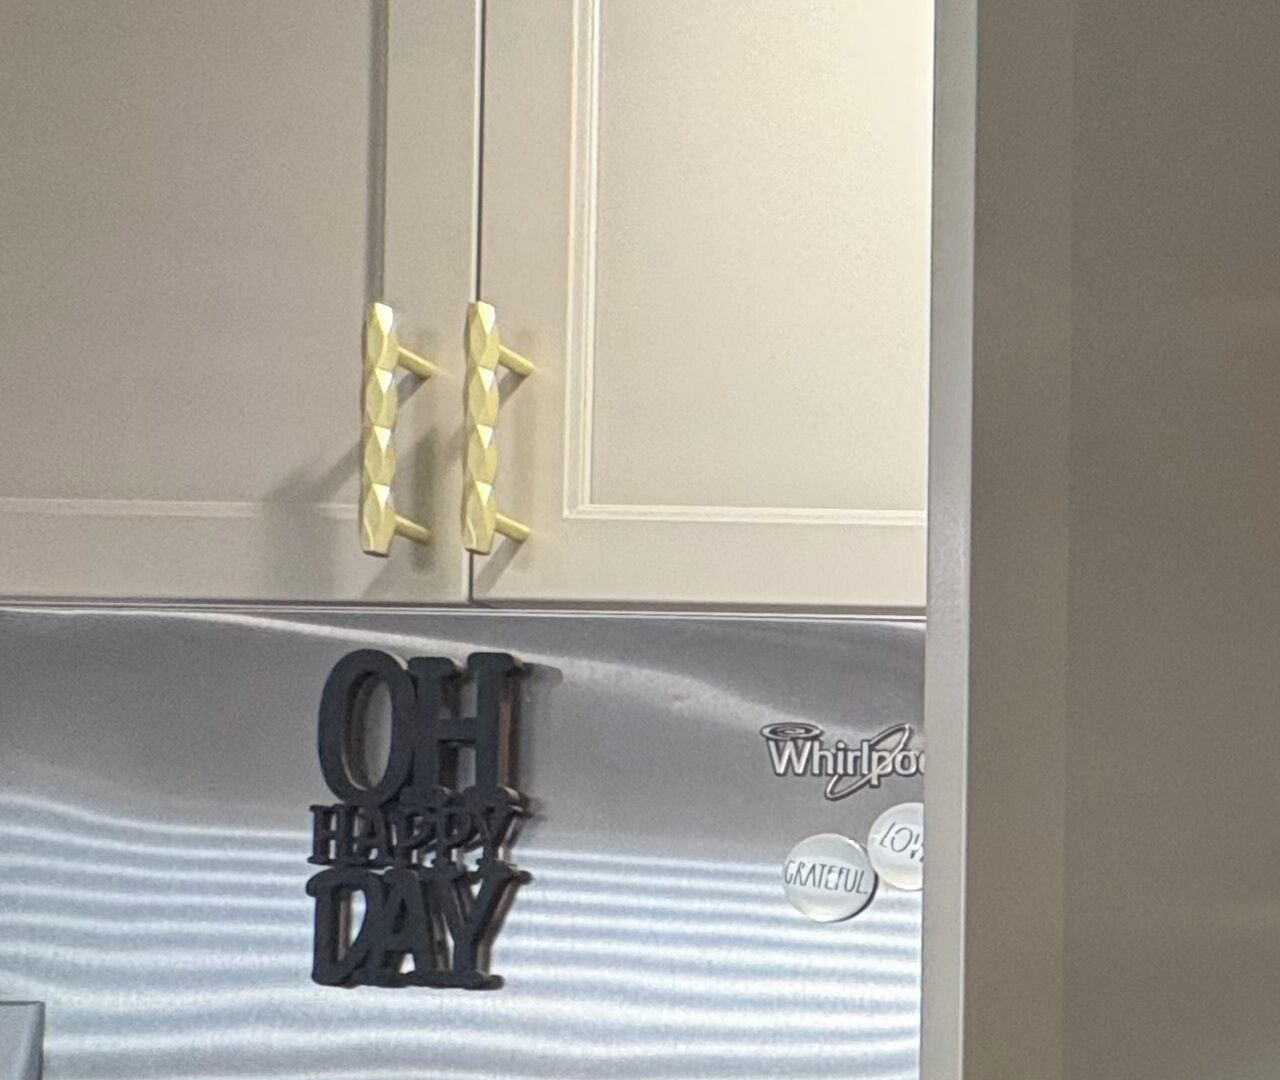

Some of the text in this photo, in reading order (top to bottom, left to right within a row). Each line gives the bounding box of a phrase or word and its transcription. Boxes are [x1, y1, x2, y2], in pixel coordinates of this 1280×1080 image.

[317, 649, 520, 806] OH
[307, 803, 525, 867] HAPPY
[783, 859, 868, 895] GRATEFUL
[306, 866, 531, 990] DAY
